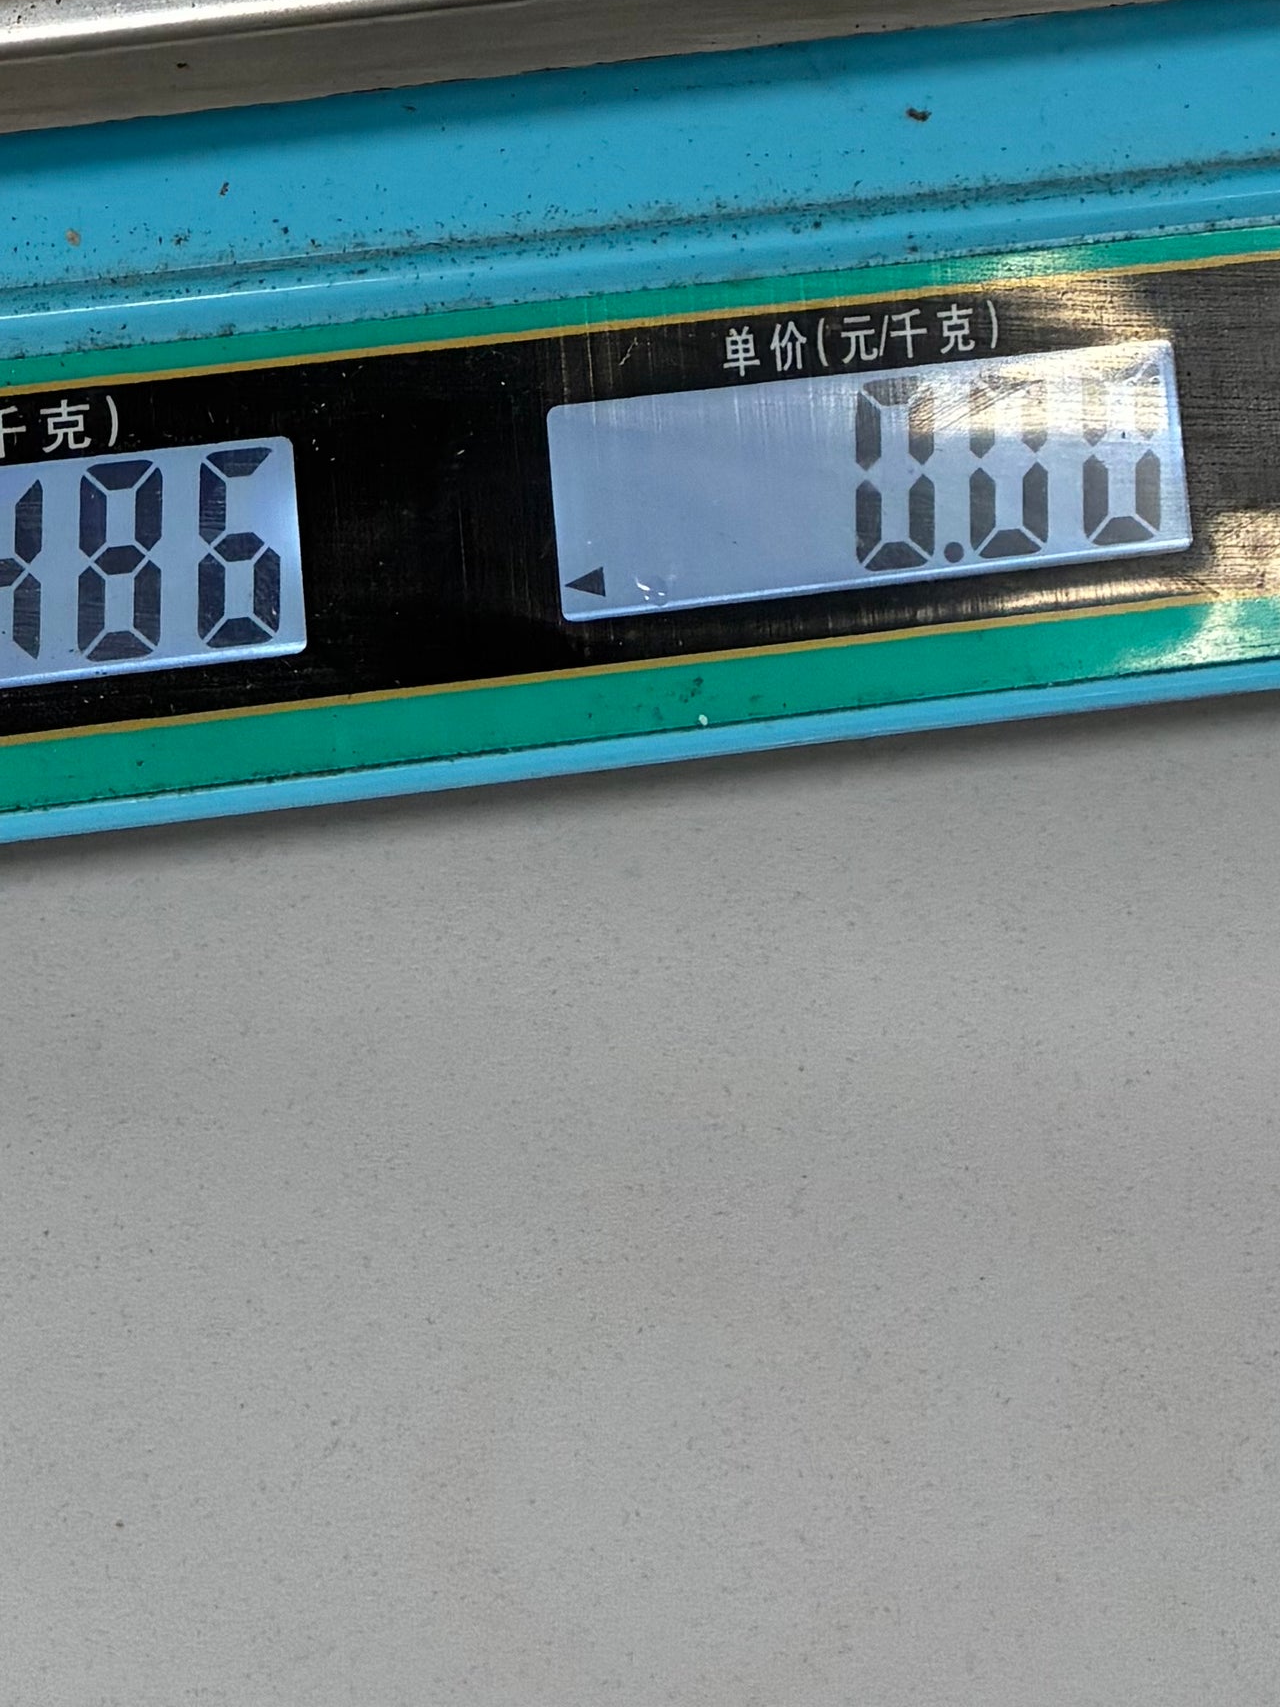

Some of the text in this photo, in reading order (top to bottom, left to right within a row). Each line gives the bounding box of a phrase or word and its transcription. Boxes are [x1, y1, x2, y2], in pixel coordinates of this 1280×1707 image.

[722, 300, 999, 377] 单价(元/千克)
